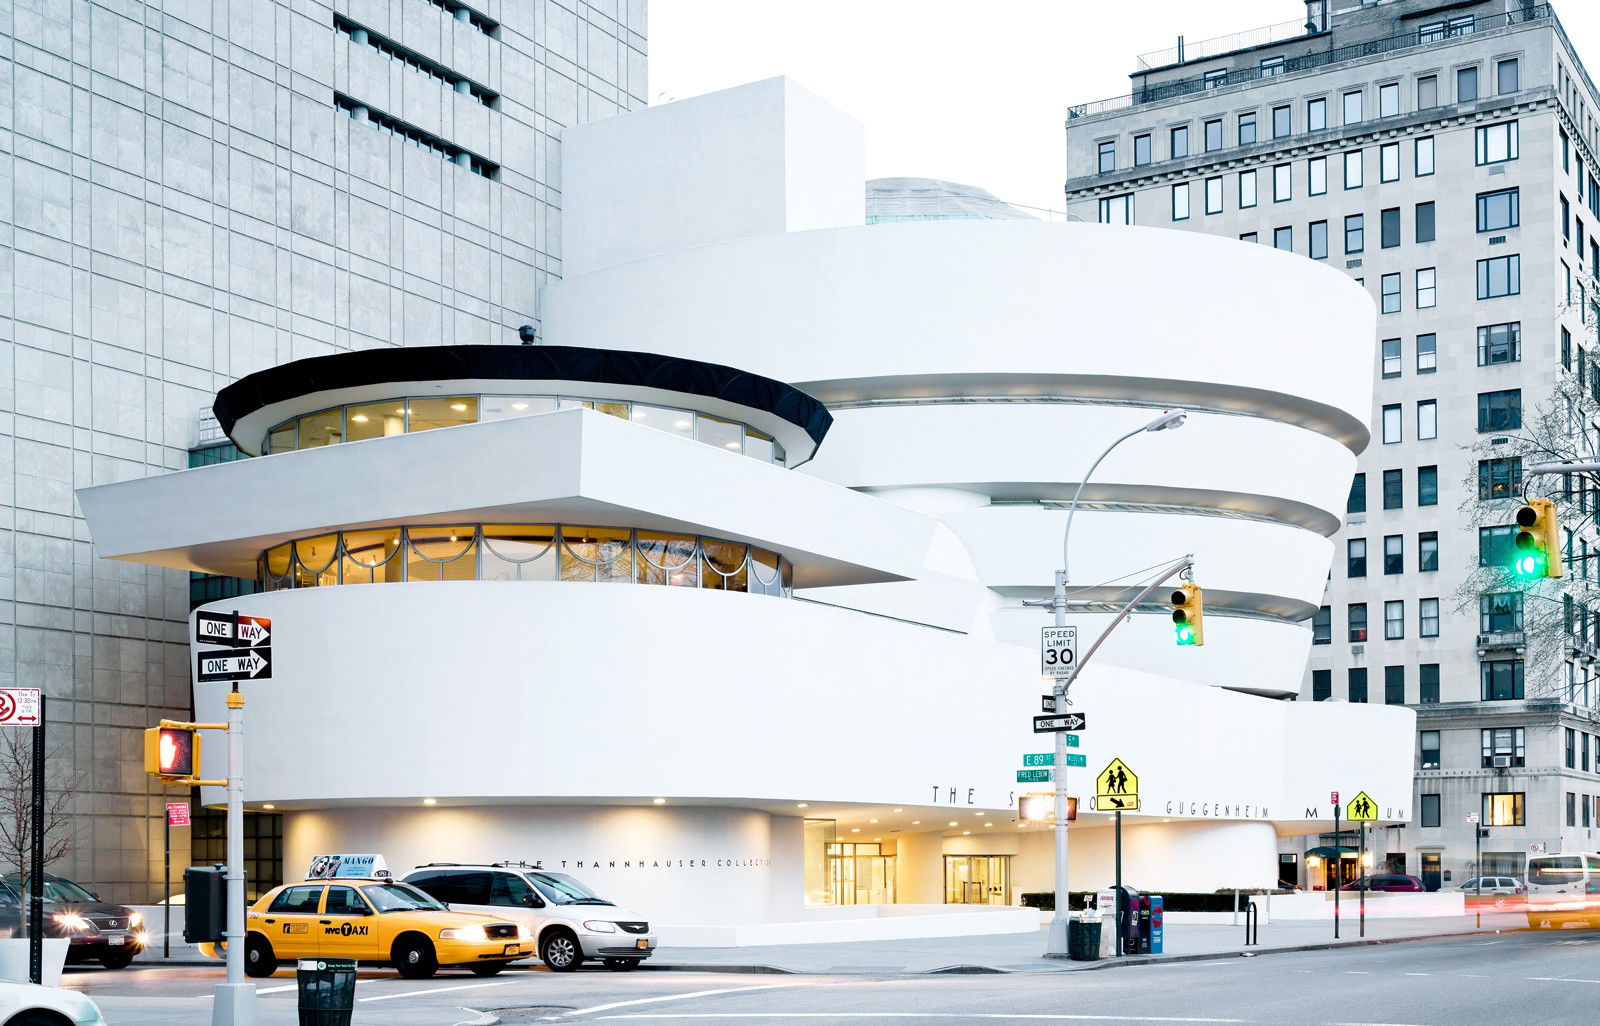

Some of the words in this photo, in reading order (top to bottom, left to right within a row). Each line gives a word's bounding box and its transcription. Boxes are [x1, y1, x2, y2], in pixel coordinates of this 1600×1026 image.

[206, 621, 227, 636] ONE
[241, 625, 262, 639] WAY
[1044, 630, 1075, 638] SPEED
[1047, 639, 1071, 647] LIMIT
[1045, 648, 1073, 665] 30
[207, 659, 228, 673] ONE
[237, 657, 260, 671] WAY
[1045, 700, 1054, 708] ONE
[1040, 720, 1055, 728] ONE
[1026, 755, 1031, 765] E
[1033, 755, 1044, 765] 89
[933, 786, 975, 804] THE
[1166, 801, 1269, 818] GUGGENHEIM
[1305, 807, 1404, 820] MUM
[343, 857, 374, 865] MANGO
[504, 860, 543, 869] THE
[561, 859, 706, 868] THANNHAUSER
